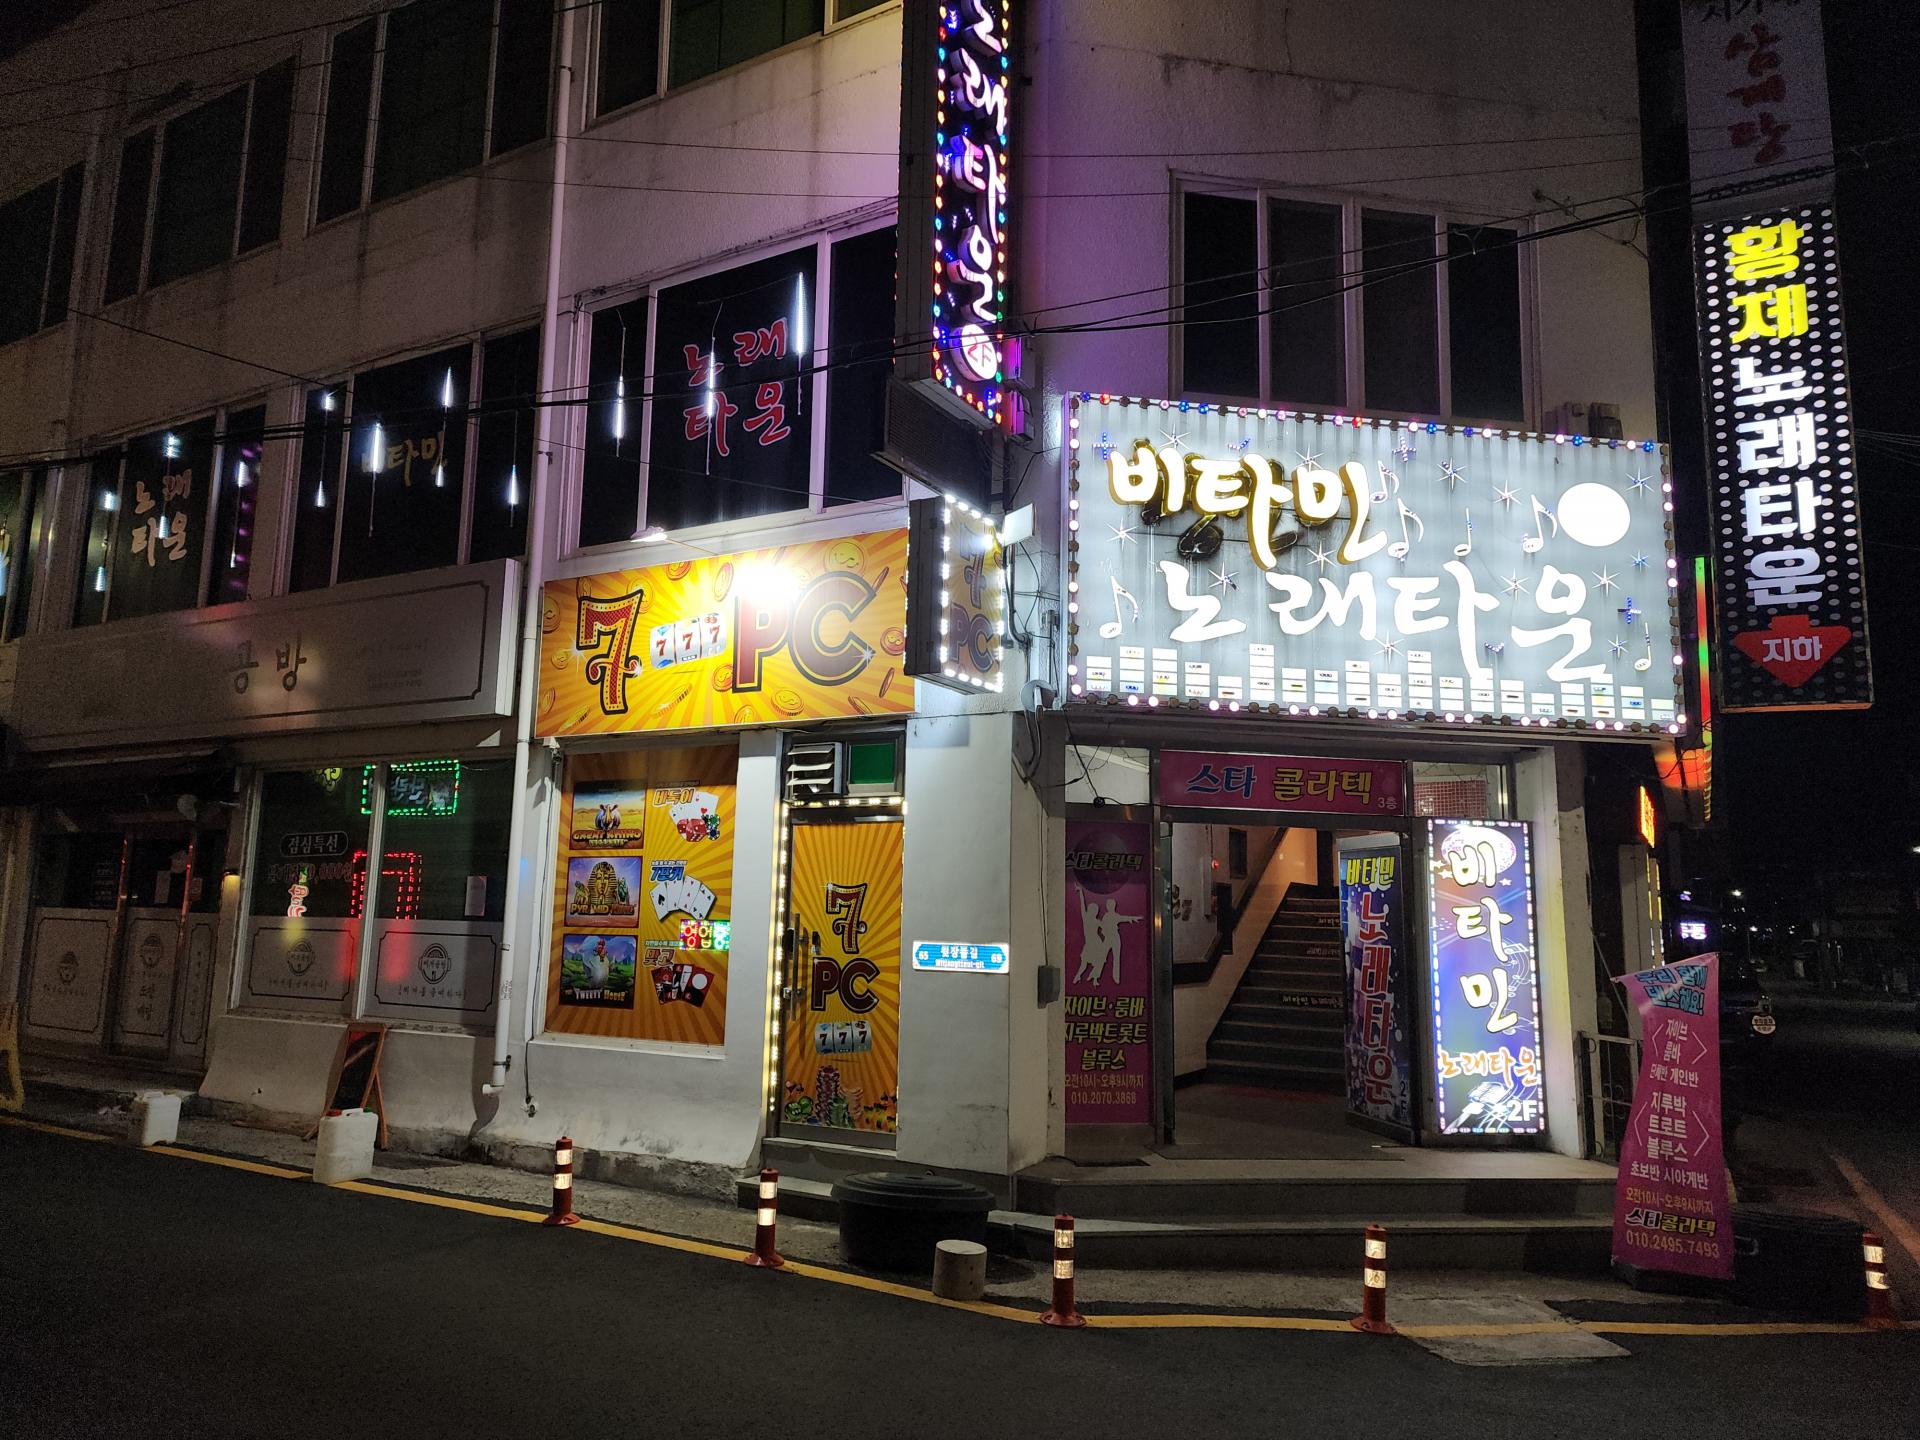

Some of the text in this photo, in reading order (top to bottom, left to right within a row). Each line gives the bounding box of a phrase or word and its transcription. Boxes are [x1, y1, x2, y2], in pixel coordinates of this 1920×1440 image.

[1727, 220, 1808, 344] 황제
[1733, 356, 1826, 606] 노래타운
[1109, 446, 1387, 569] 비타민
[732, 570, 877, 693] PC
[1160, 560, 1611, 683] 노래타운
[576, 588, 643, 715] 7
[951, 603, 995, 673] PC
[1762, 636, 1822, 662] 지하
[653, 788, 695, 806] 바둑이
[1185, 764, 1372, 804] 스타 콜라텍
[1377, 797, 1398, 809] 3층
[287, 834, 338, 854] 점심특선
[1346, 857, 1395, 886] 비타민
[826, 883, 868, 954] 7
[1449, 841, 1519, 1034] 비타민
[811, 957, 880, 1014] PC
[1635, 965, 1708, 989] 우리 함께
[1360, 892, 1394, 1106] 노래타운
[1666, 1019, 1688, 1040] 자이브
[1082, 1050, 1126, 1070] 블루스
[1440, 1046, 1539, 1087] 노래타운
[1671, 1067, 1699, 1087] 개인반
[1508, 1100, 1537, 1122] 2F
[1651, 1091, 1687, 1117] 지루박
[1648, 1115, 1688, 1138] 트로트
[1647, 1136, 1688, 1162] 블루스
[1630, 1161, 1660, 1182] 초보반
[1626, 1230, 1720, 1258] 010.2495.7493
